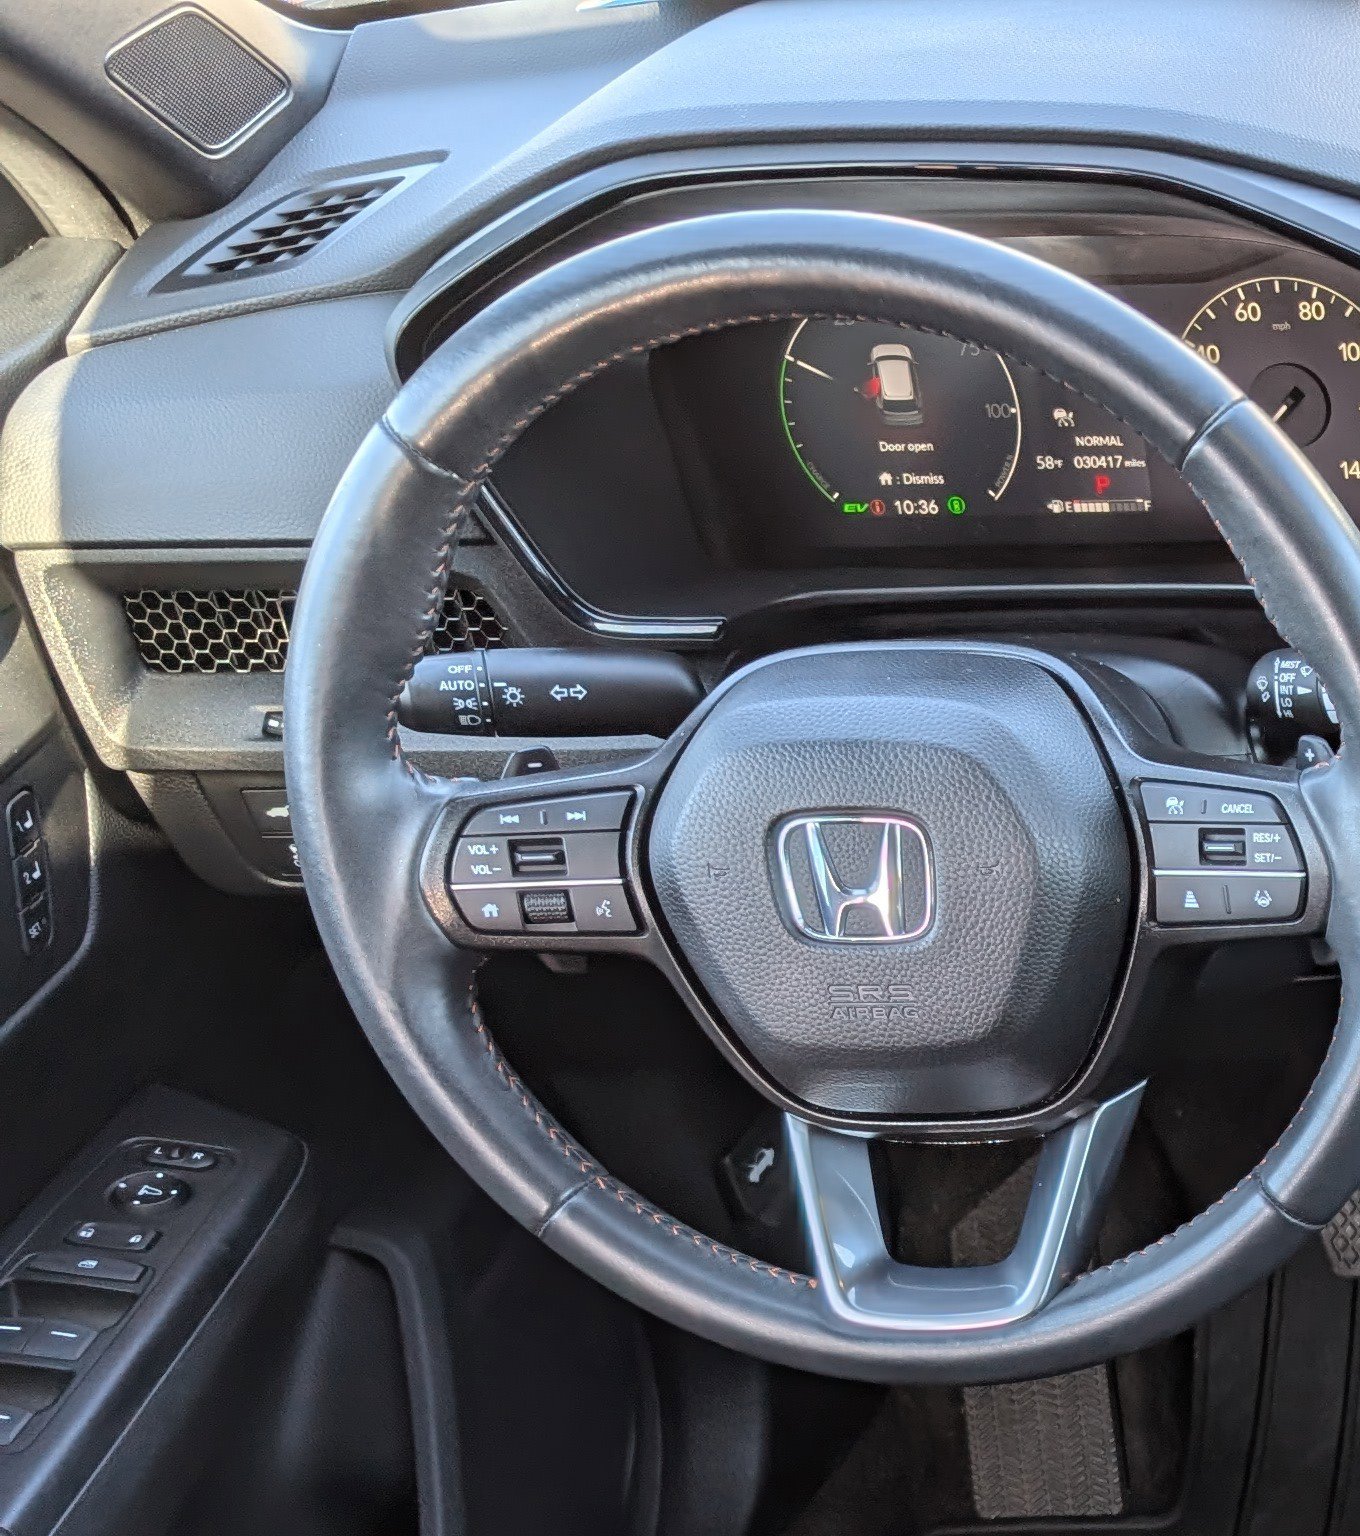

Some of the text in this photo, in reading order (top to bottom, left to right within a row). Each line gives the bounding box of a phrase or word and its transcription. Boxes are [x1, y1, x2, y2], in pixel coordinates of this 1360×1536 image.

[1235, 302, 1261, 322] 60
[1298, 301, 1325, 321] 80
[1271, 322, 1291, 331] mph
[985, 403, 1011, 418] 100
[879, 441, 934, 453] Door open
[1075, 435, 1124, 447] NORMAL
[1073, 455, 1123, 469] 030417
[902, 473, 945, 485] Dismiss
[1095, 475, 1111, 494] P
[843, 503, 869, 514] EV
[894, 499, 939, 515] 10:36
[447, 664, 473, 674] OFF
[1279, 673, 1296, 683] OFF
[439, 680, 475, 691] AUTO
[1221, 803, 1255, 814] CANCEL
[1252, 832, 1281, 843] RES/+
[467, 844, 499, 855] VOL+
[827, 983, 914, 1002] SRS
[830, 1006, 919, 1020] AIRBAG
